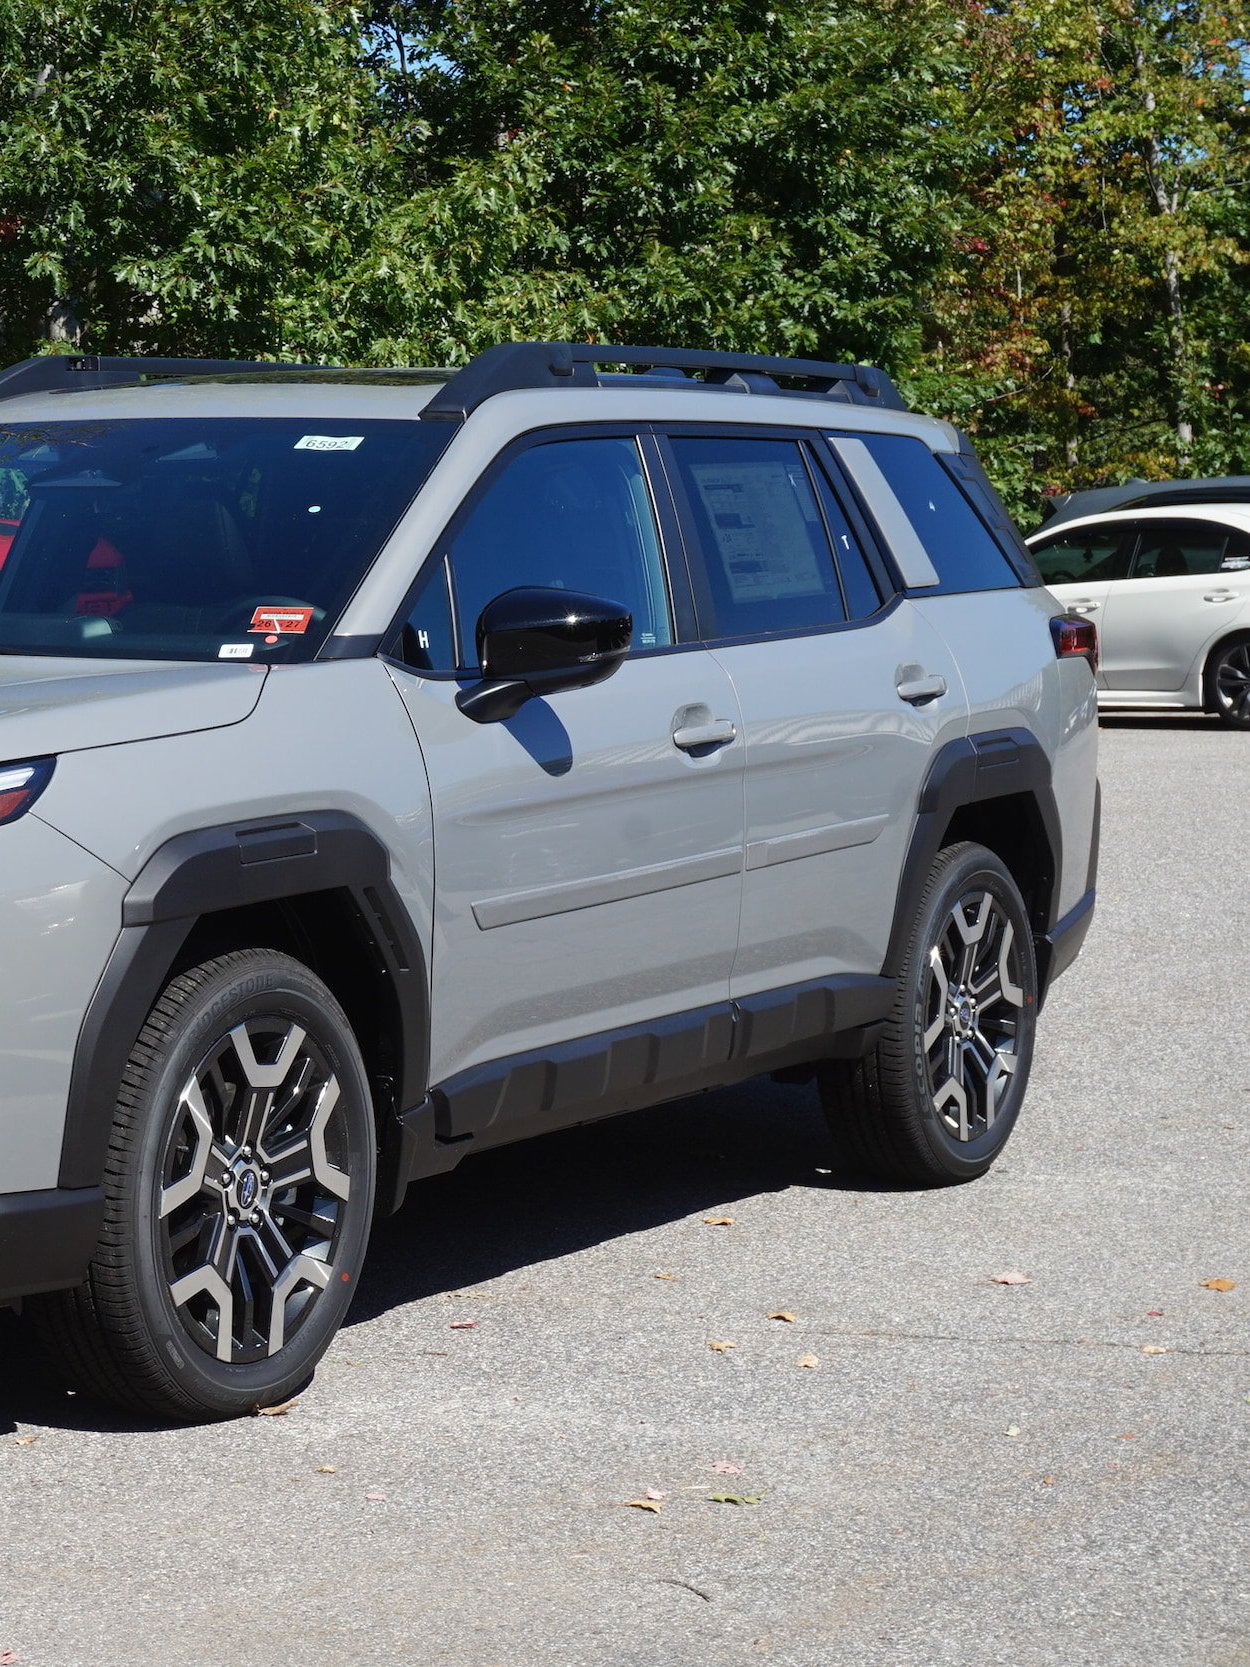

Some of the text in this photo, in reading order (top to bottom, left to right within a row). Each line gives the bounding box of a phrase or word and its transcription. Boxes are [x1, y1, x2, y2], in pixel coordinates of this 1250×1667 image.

[306, 440, 348, 449] 6592
[285, 620, 302, 629] 27
[417, 629, 430, 649] H
